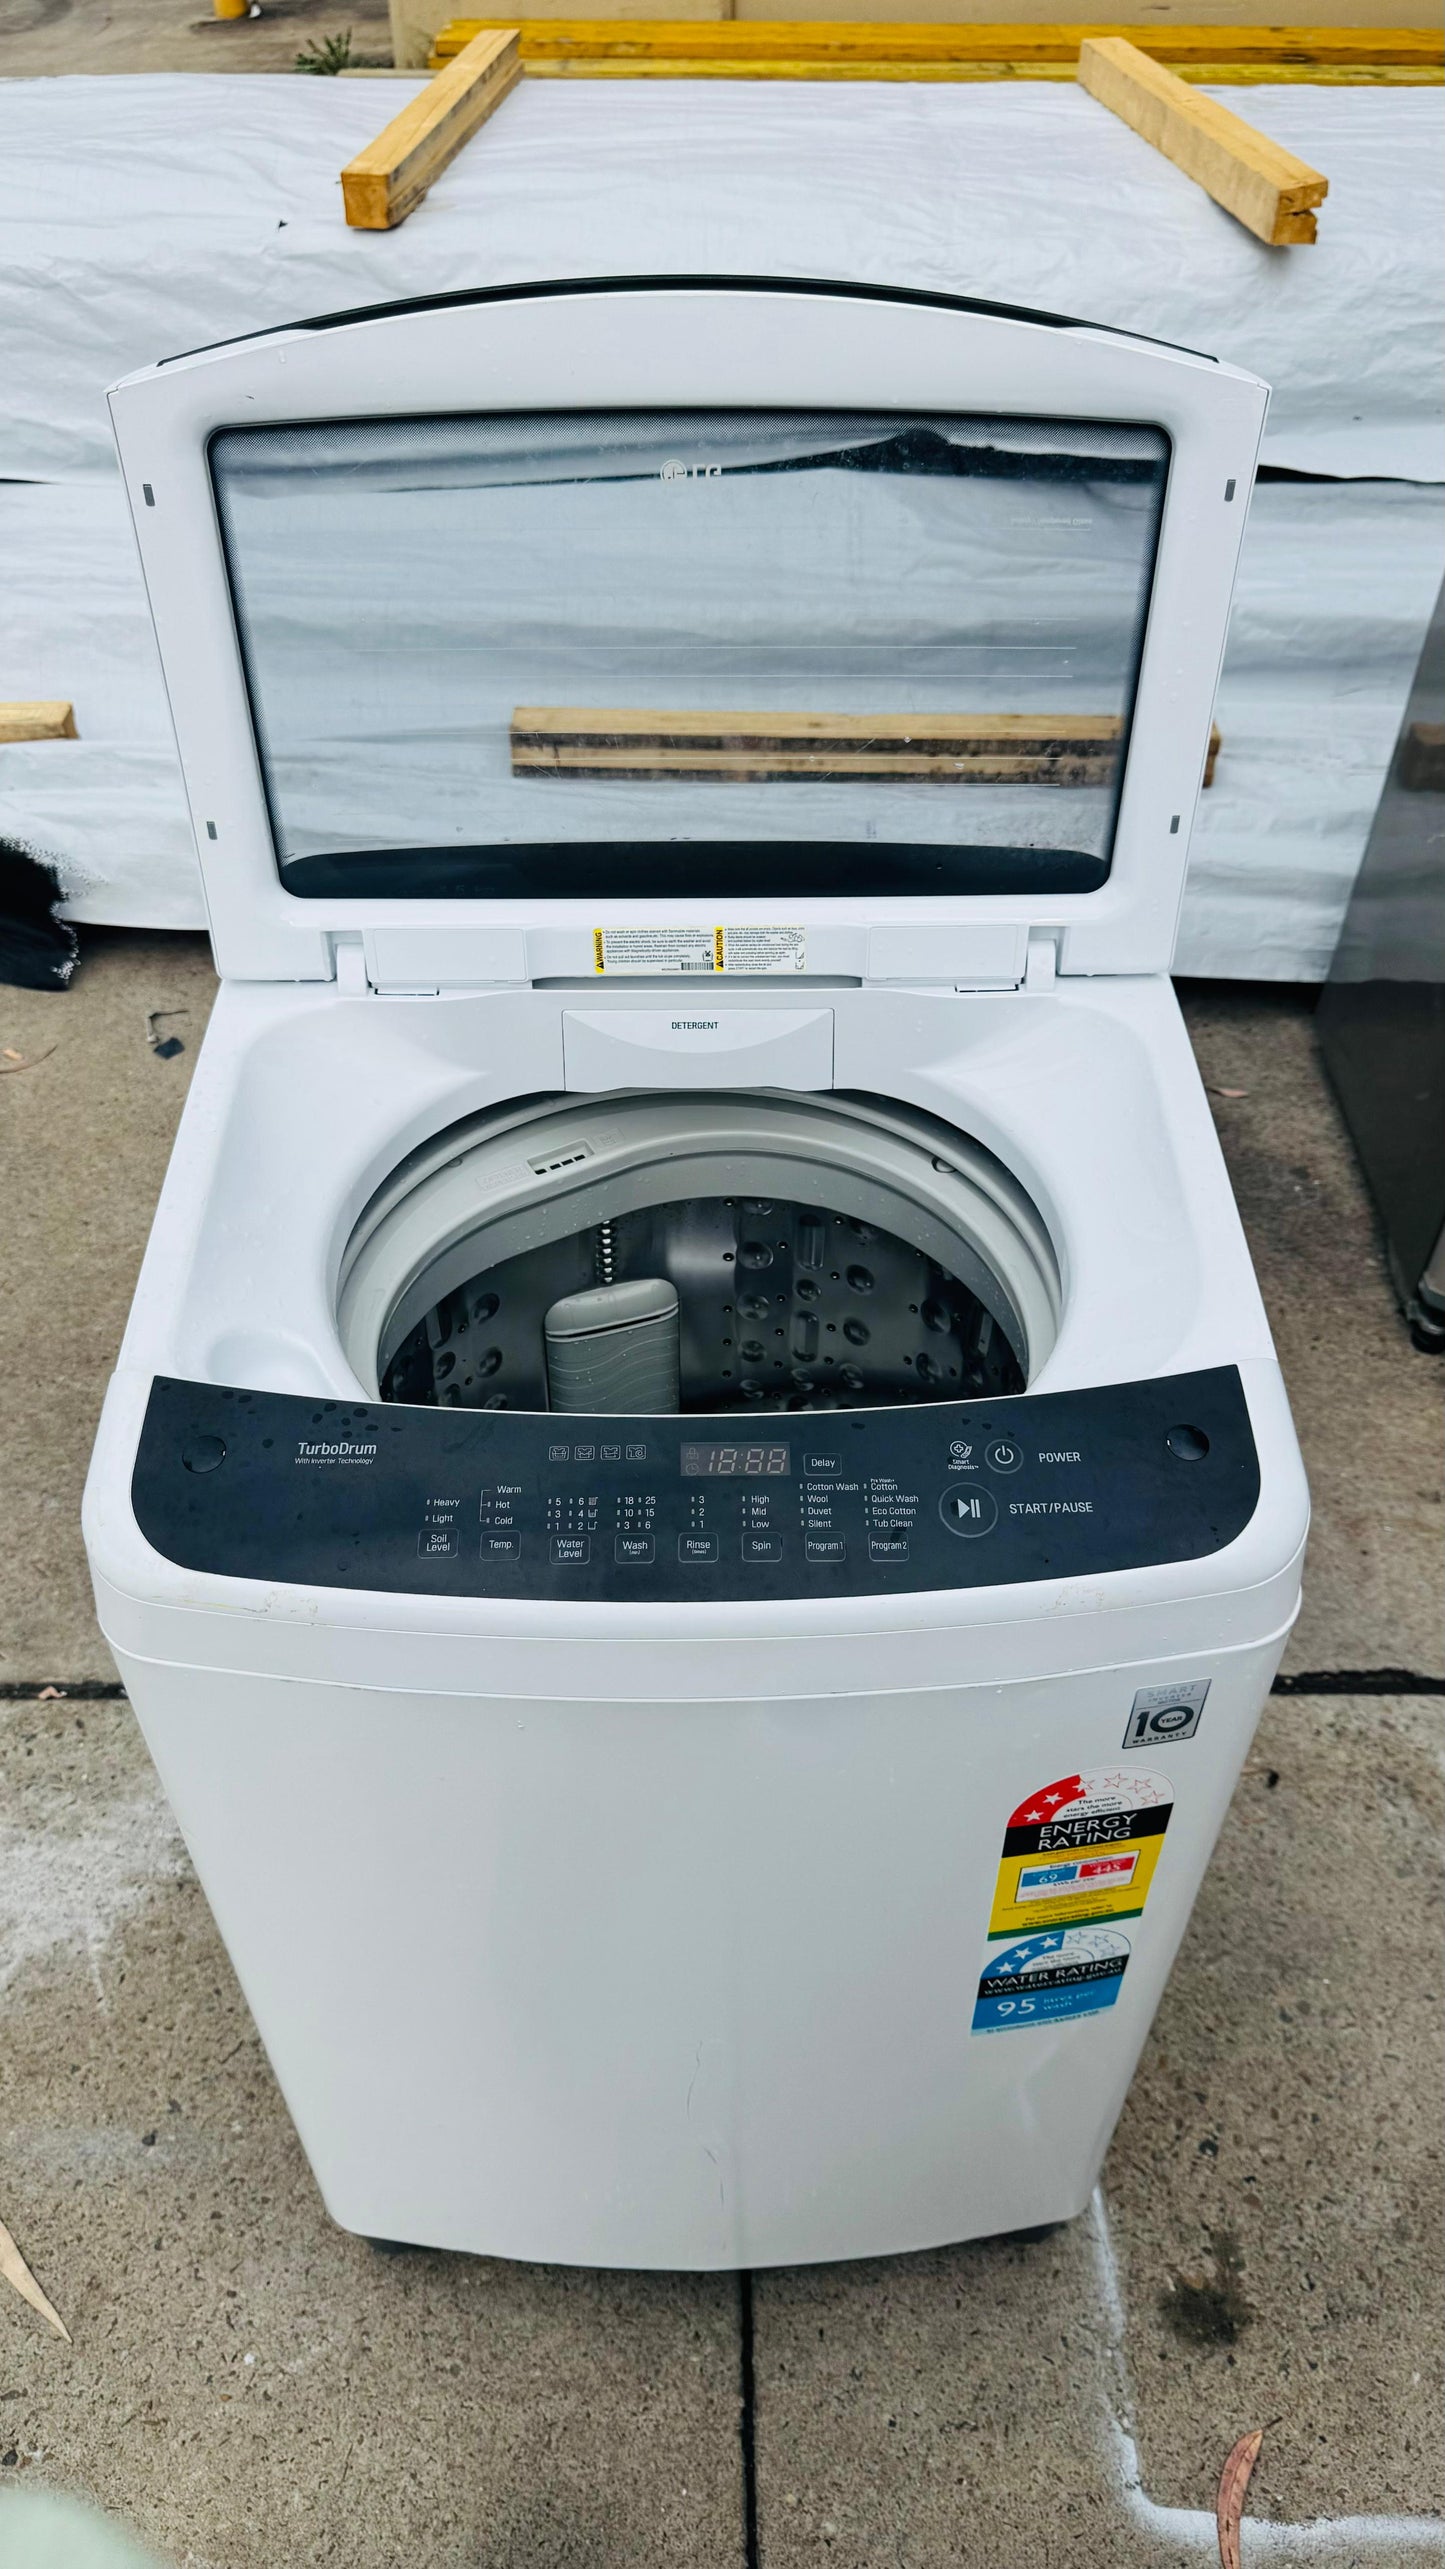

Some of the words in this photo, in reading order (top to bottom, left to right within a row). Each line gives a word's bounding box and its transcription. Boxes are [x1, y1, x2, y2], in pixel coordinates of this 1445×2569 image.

[672, 1022, 719, 1030] DETERGENT
[298, 1442, 377, 1455] TurboDrum
[1038, 1452, 1081, 1463] POWER
[811, 1458, 835, 1468] Delay
[497, 1486, 521, 1494] Warm
[807, 1482, 834, 1491] Cotton
[835, 1482, 859, 1490] Wash
[870, 1483, 897, 1491] Cotton
[434, 1499, 460, 1507] Heavy
[578, 1497, 584, 1505] 6
[624, 1496, 634, 1505] 18
[645, 1496, 656, 1504] 25
[698, 1496, 704, 1504] 3
[751, 1495, 769, 1504] High
[807, 1495, 828, 1503] Wool
[872, 1495, 893, 1503] Quick
[895, 1495, 919, 1503] Wash
[698, 1508, 704, 1516] 2
[751, 1507, 766, 1515] Mid
[808, 1507, 832, 1515] Duvet
[873, 1507, 887, 1515] Eco
[889, 1507, 916, 1515] Cotton
[1009, 1502, 1094, 1514] START/PAUSE
[555, 1510, 561, 1518] 3
[624, 1509, 634, 1517] 10
[646, 1509, 654, 1517] 15
[432, 1515, 453, 1524] Light
[494, 1517, 513, 1525] Cold
[700, 1520, 704, 1528] 1
[751, 1520, 769, 1528] Low
[808, 1519, 831, 1528] Silent
[873, 1519, 888, 1527] Tub
[890, 1519, 913, 1527] Clean
[555, 1522, 559, 1530] 1
[578, 1522, 583, 1530] 2
[624, 1521, 630, 1529] 3
[645, 1521, 651, 1529] 6
[431, 1534, 447, 1543] Soil
[426, 1542, 450, 1552] Level
[489, 1540, 514, 1550] Temp.
[557, 1539, 584, 1548] Water
[622, 1541, 648, 1549] Wash
[686, 1540, 710, 1549] Rinse
[752, 1541, 771, 1551] Spin
[808, 1541, 838, 1551] Program
[872, 1541, 902, 1551] Program
[903, 1541, 907, 1549] 2
[559, 1549, 582, 1558] Level
[1136, 1706, 1194, 1737] 10
[1161, 1716, 1183, 1724] YEAR
[1133, 1731, 1186, 1744] WARRANTY
[1040, 1813, 1137, 1838] ENERGY
[1038, 1827, 1132, 1851] RATING
[1039, 1873, 1057, 1883] 69
[988, 1971, 1049, 1988] WATER
[1055, 1960, 1122, 1977] RATING
[997, 1998, 1036, 2017] 95
